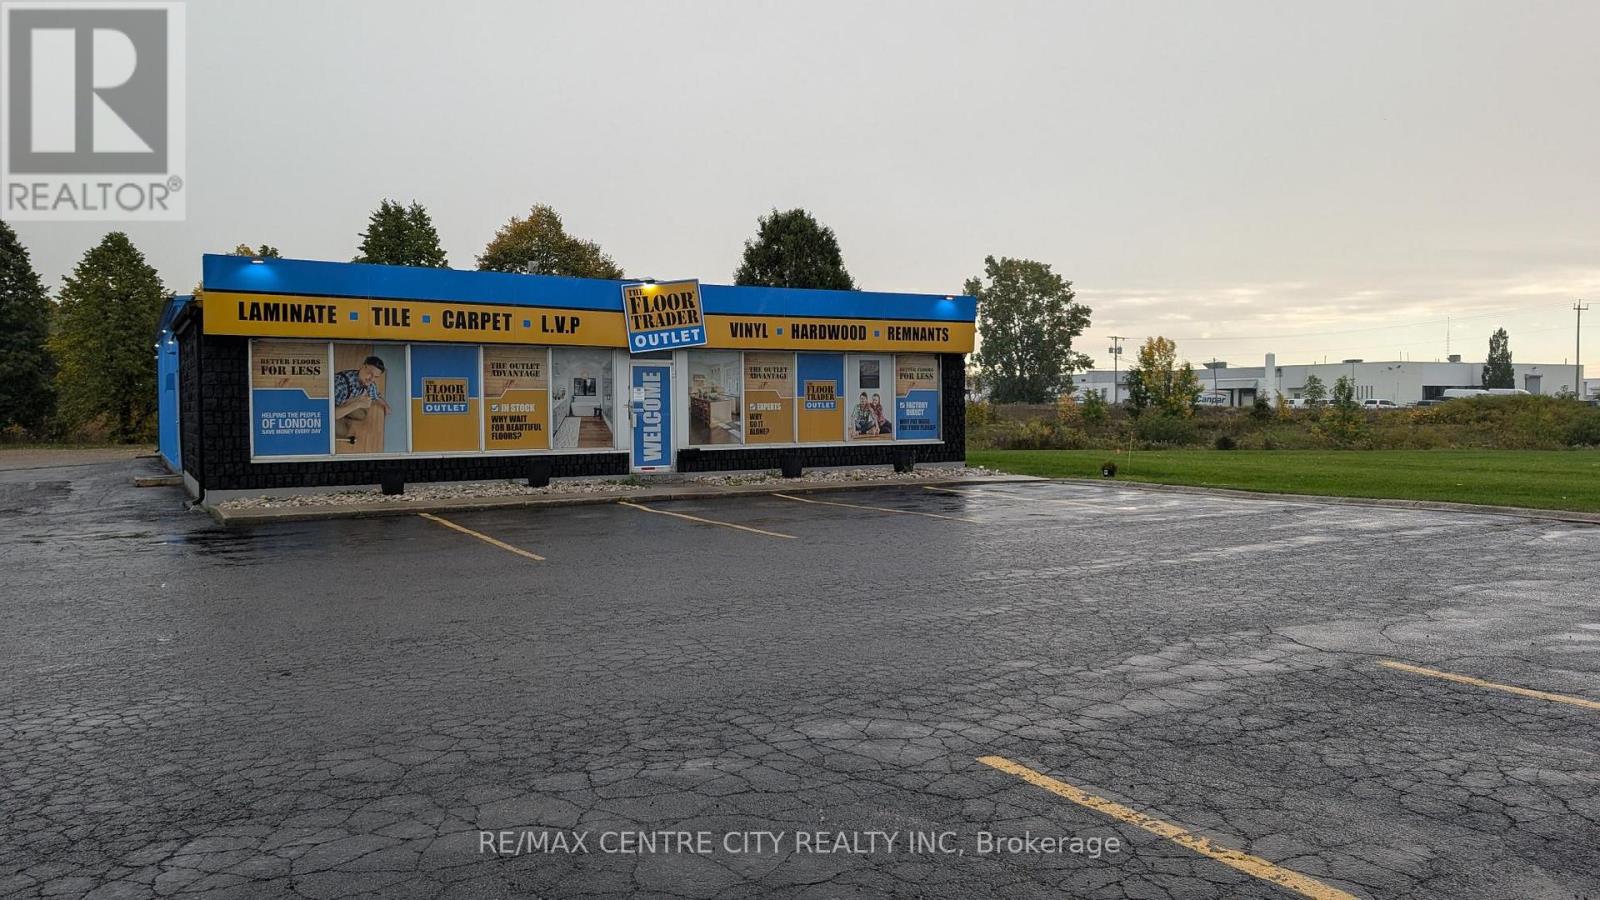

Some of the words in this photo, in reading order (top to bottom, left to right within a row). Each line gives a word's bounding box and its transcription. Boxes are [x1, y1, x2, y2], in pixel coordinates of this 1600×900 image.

[628, 288, 644, 296] THE
[629, 291, 696, 315] FLOOR
[238, 301, 337, 324] LAMINATE
[371, 307, 411, 328] TILE
[442, 309, 513, 332] CARPET
[541, 314, 581, 334] L.V.P
[630, 309, 699, 331] TRADER
[729, 322, 769, 339] VINYL
[791, 323, 867, 341] HARDWOOD
[887, 326, 949, 342] REMNANTS
[634, 328, 700, 348] OUTLET
[491, 362, 507, 370] THE
[509, 362, 540, 370] OUTLET
[261, 366, 287, 376] FOR
[291, 366, 321, 376] LESS
[916, 372, 934, 380] LESS
[425, 384, 465, 394] FLOOR
[807, 385, 834, 394] FLOOR
[425, 394, 466, 402] TRADER
[425, 404, 466, 412] OUTLET
[510, 404, 536, 412] STOCK
[491, 415, 509, 423] WHY
[642, 371, 662, 462] WELCOME
[262, 418, 276, 429] OF
[279, 418, 321, 429] LONDON
[506, 423, 542, 431] BEAUTIFUL
